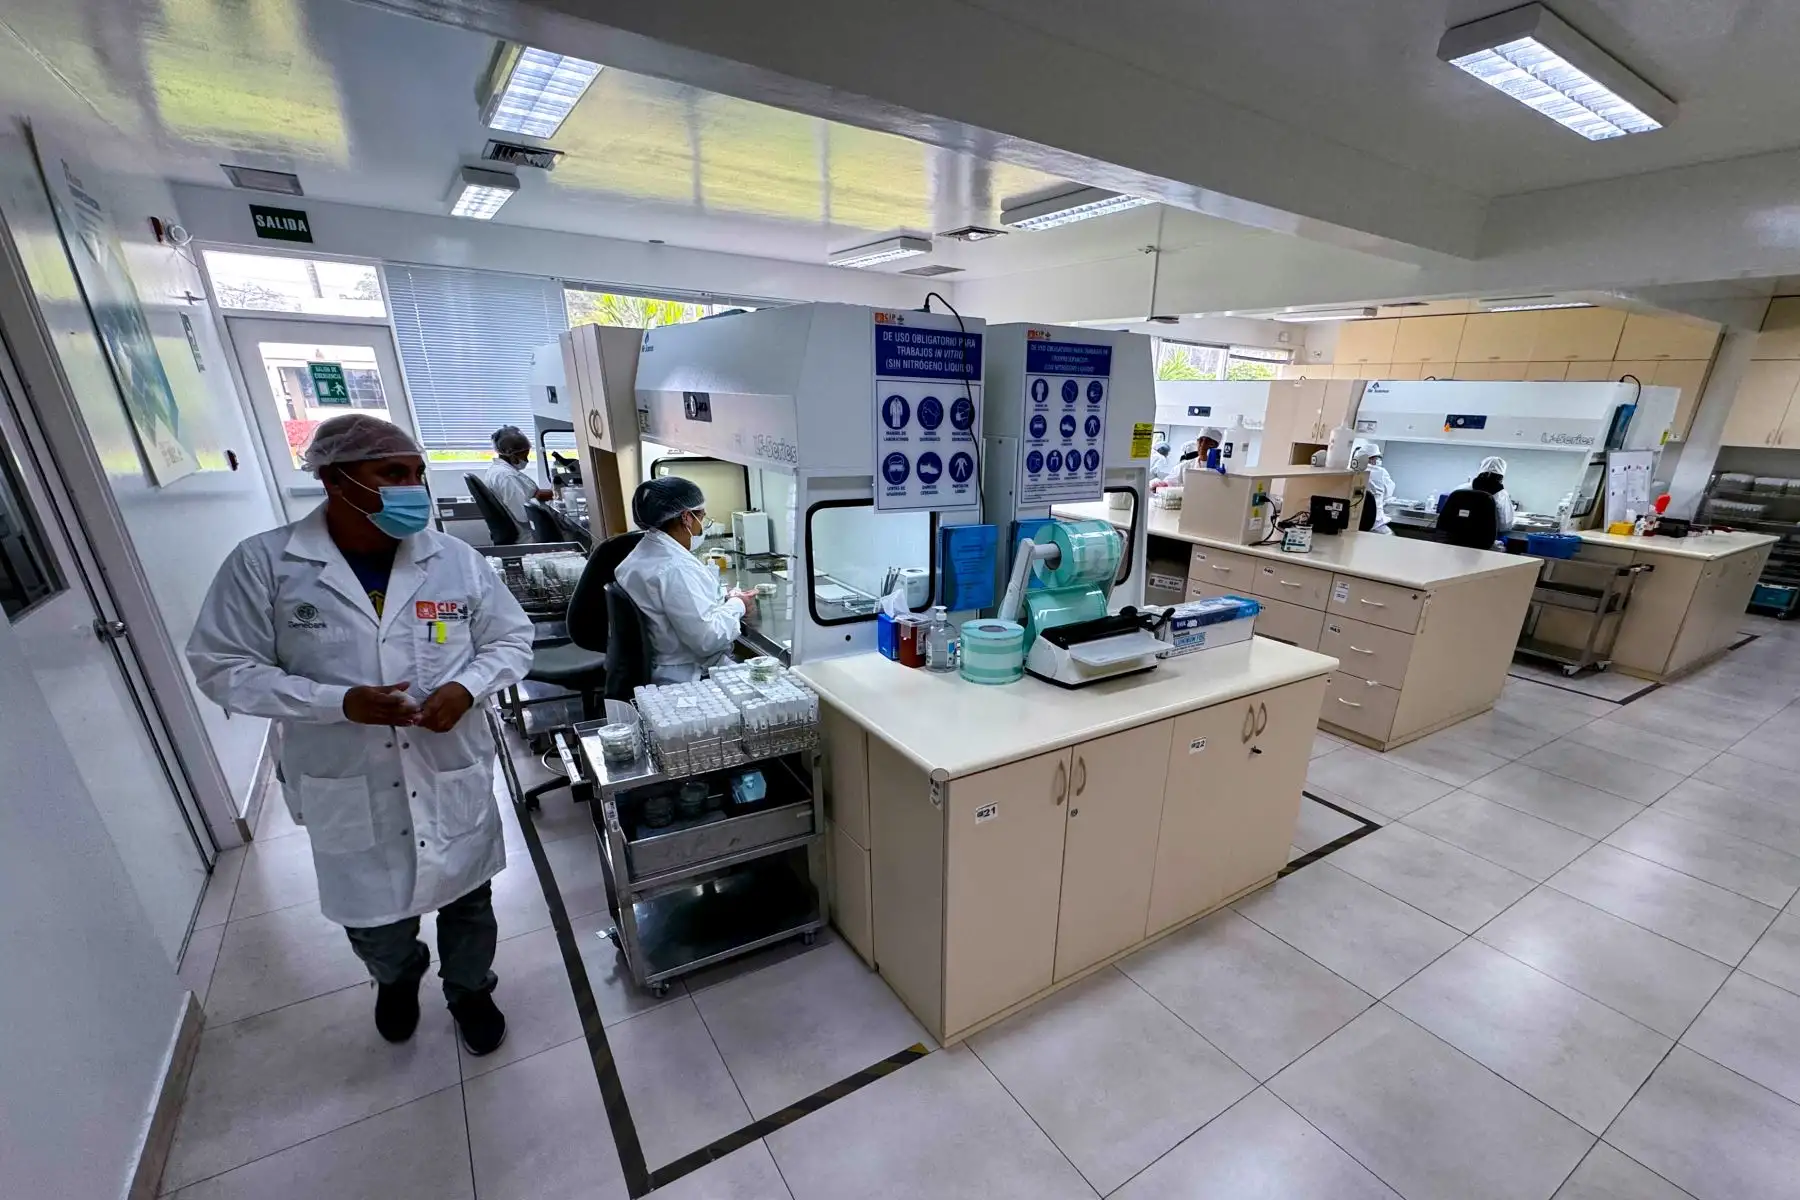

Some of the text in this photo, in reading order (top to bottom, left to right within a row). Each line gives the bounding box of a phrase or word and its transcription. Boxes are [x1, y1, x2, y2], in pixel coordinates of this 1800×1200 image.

[255, 214, 308, 233] SALIDA
[883, 331, 893, 342] DE
[895, 332, 910, 343] USO
[911, 333, 957, 346] OBLIGATORIO
[897, 345, 964, 360] TRABAJOS IN VITRO
[885, 358, 901, 370] (SIN
[902, 359, 943, 371] NITRÓGENO
[437, 602, 457, 612] CIP
